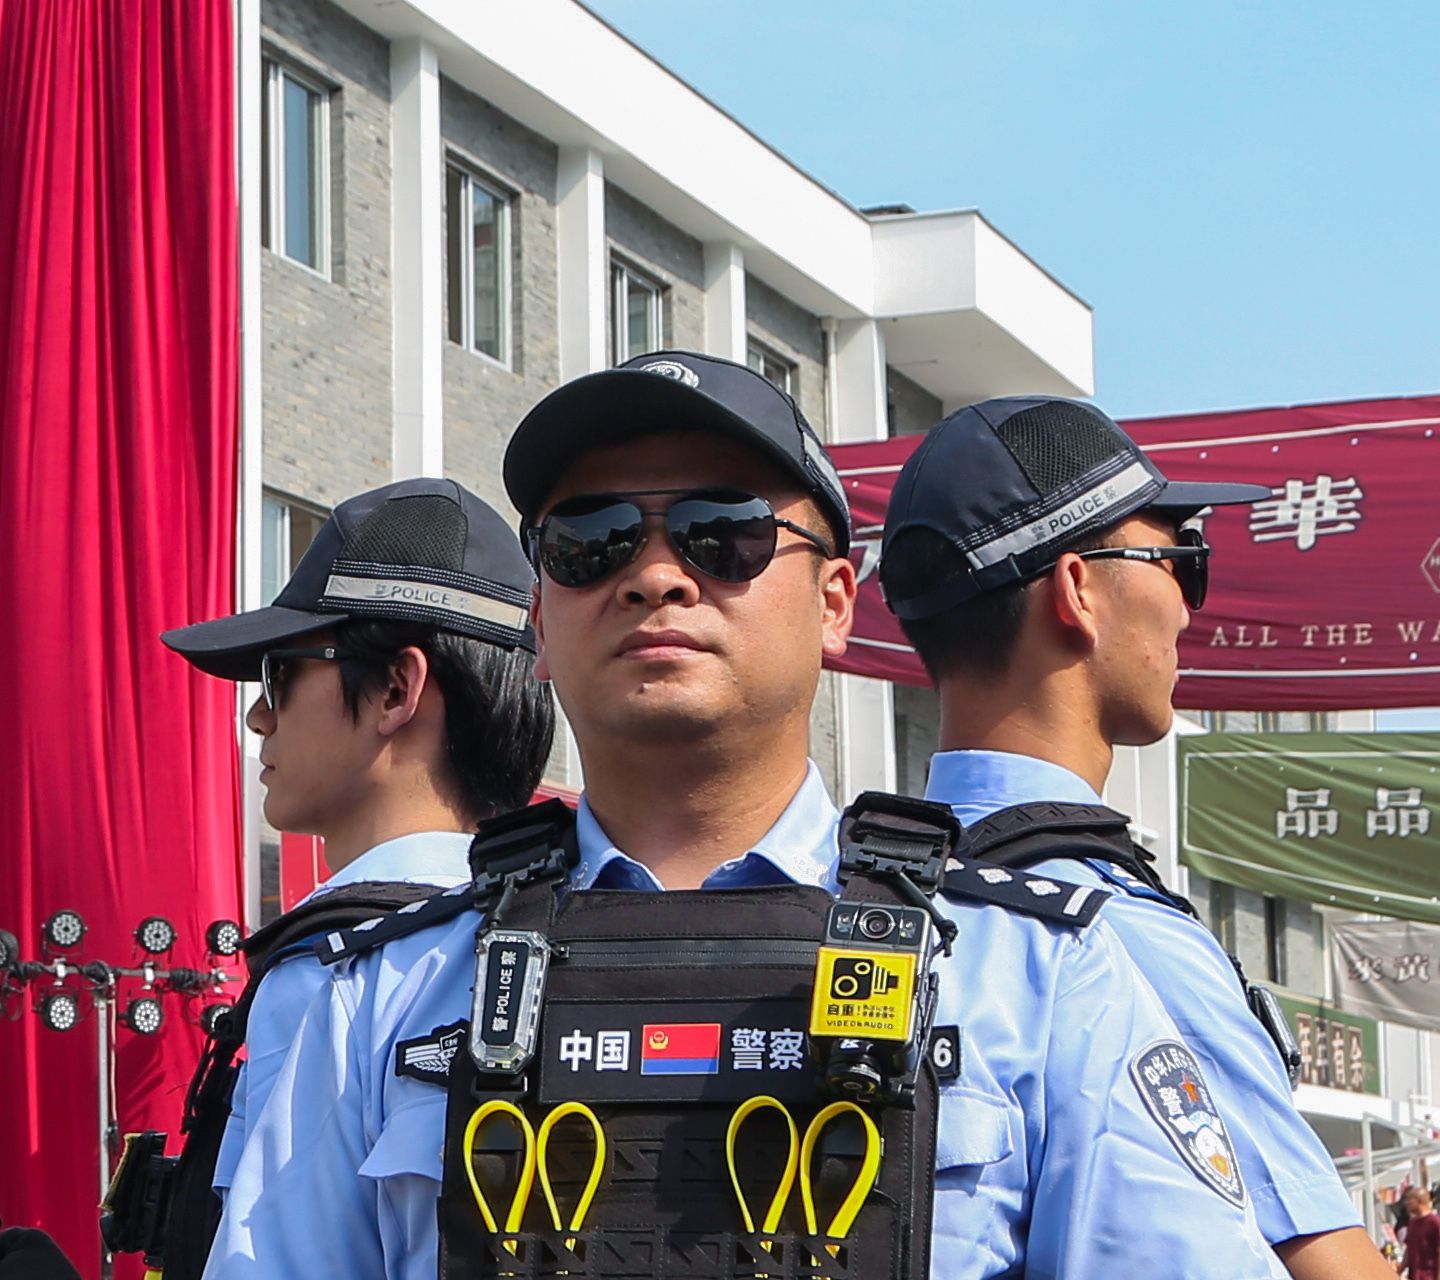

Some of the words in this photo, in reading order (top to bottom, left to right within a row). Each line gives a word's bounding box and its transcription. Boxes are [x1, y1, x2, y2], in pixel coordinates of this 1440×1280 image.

[1048, 494, 1105, 534] POLICE
[391, 585, 453, 606] POLICE
[1210, 625, 1279, 647] ALL
[1300, 623, 1374, 647] THE
[496, 968, 513, 1015] POLICE
[558, 1029, 631, 1073] 中国
[730, 1028, 804, 1071] 警察
